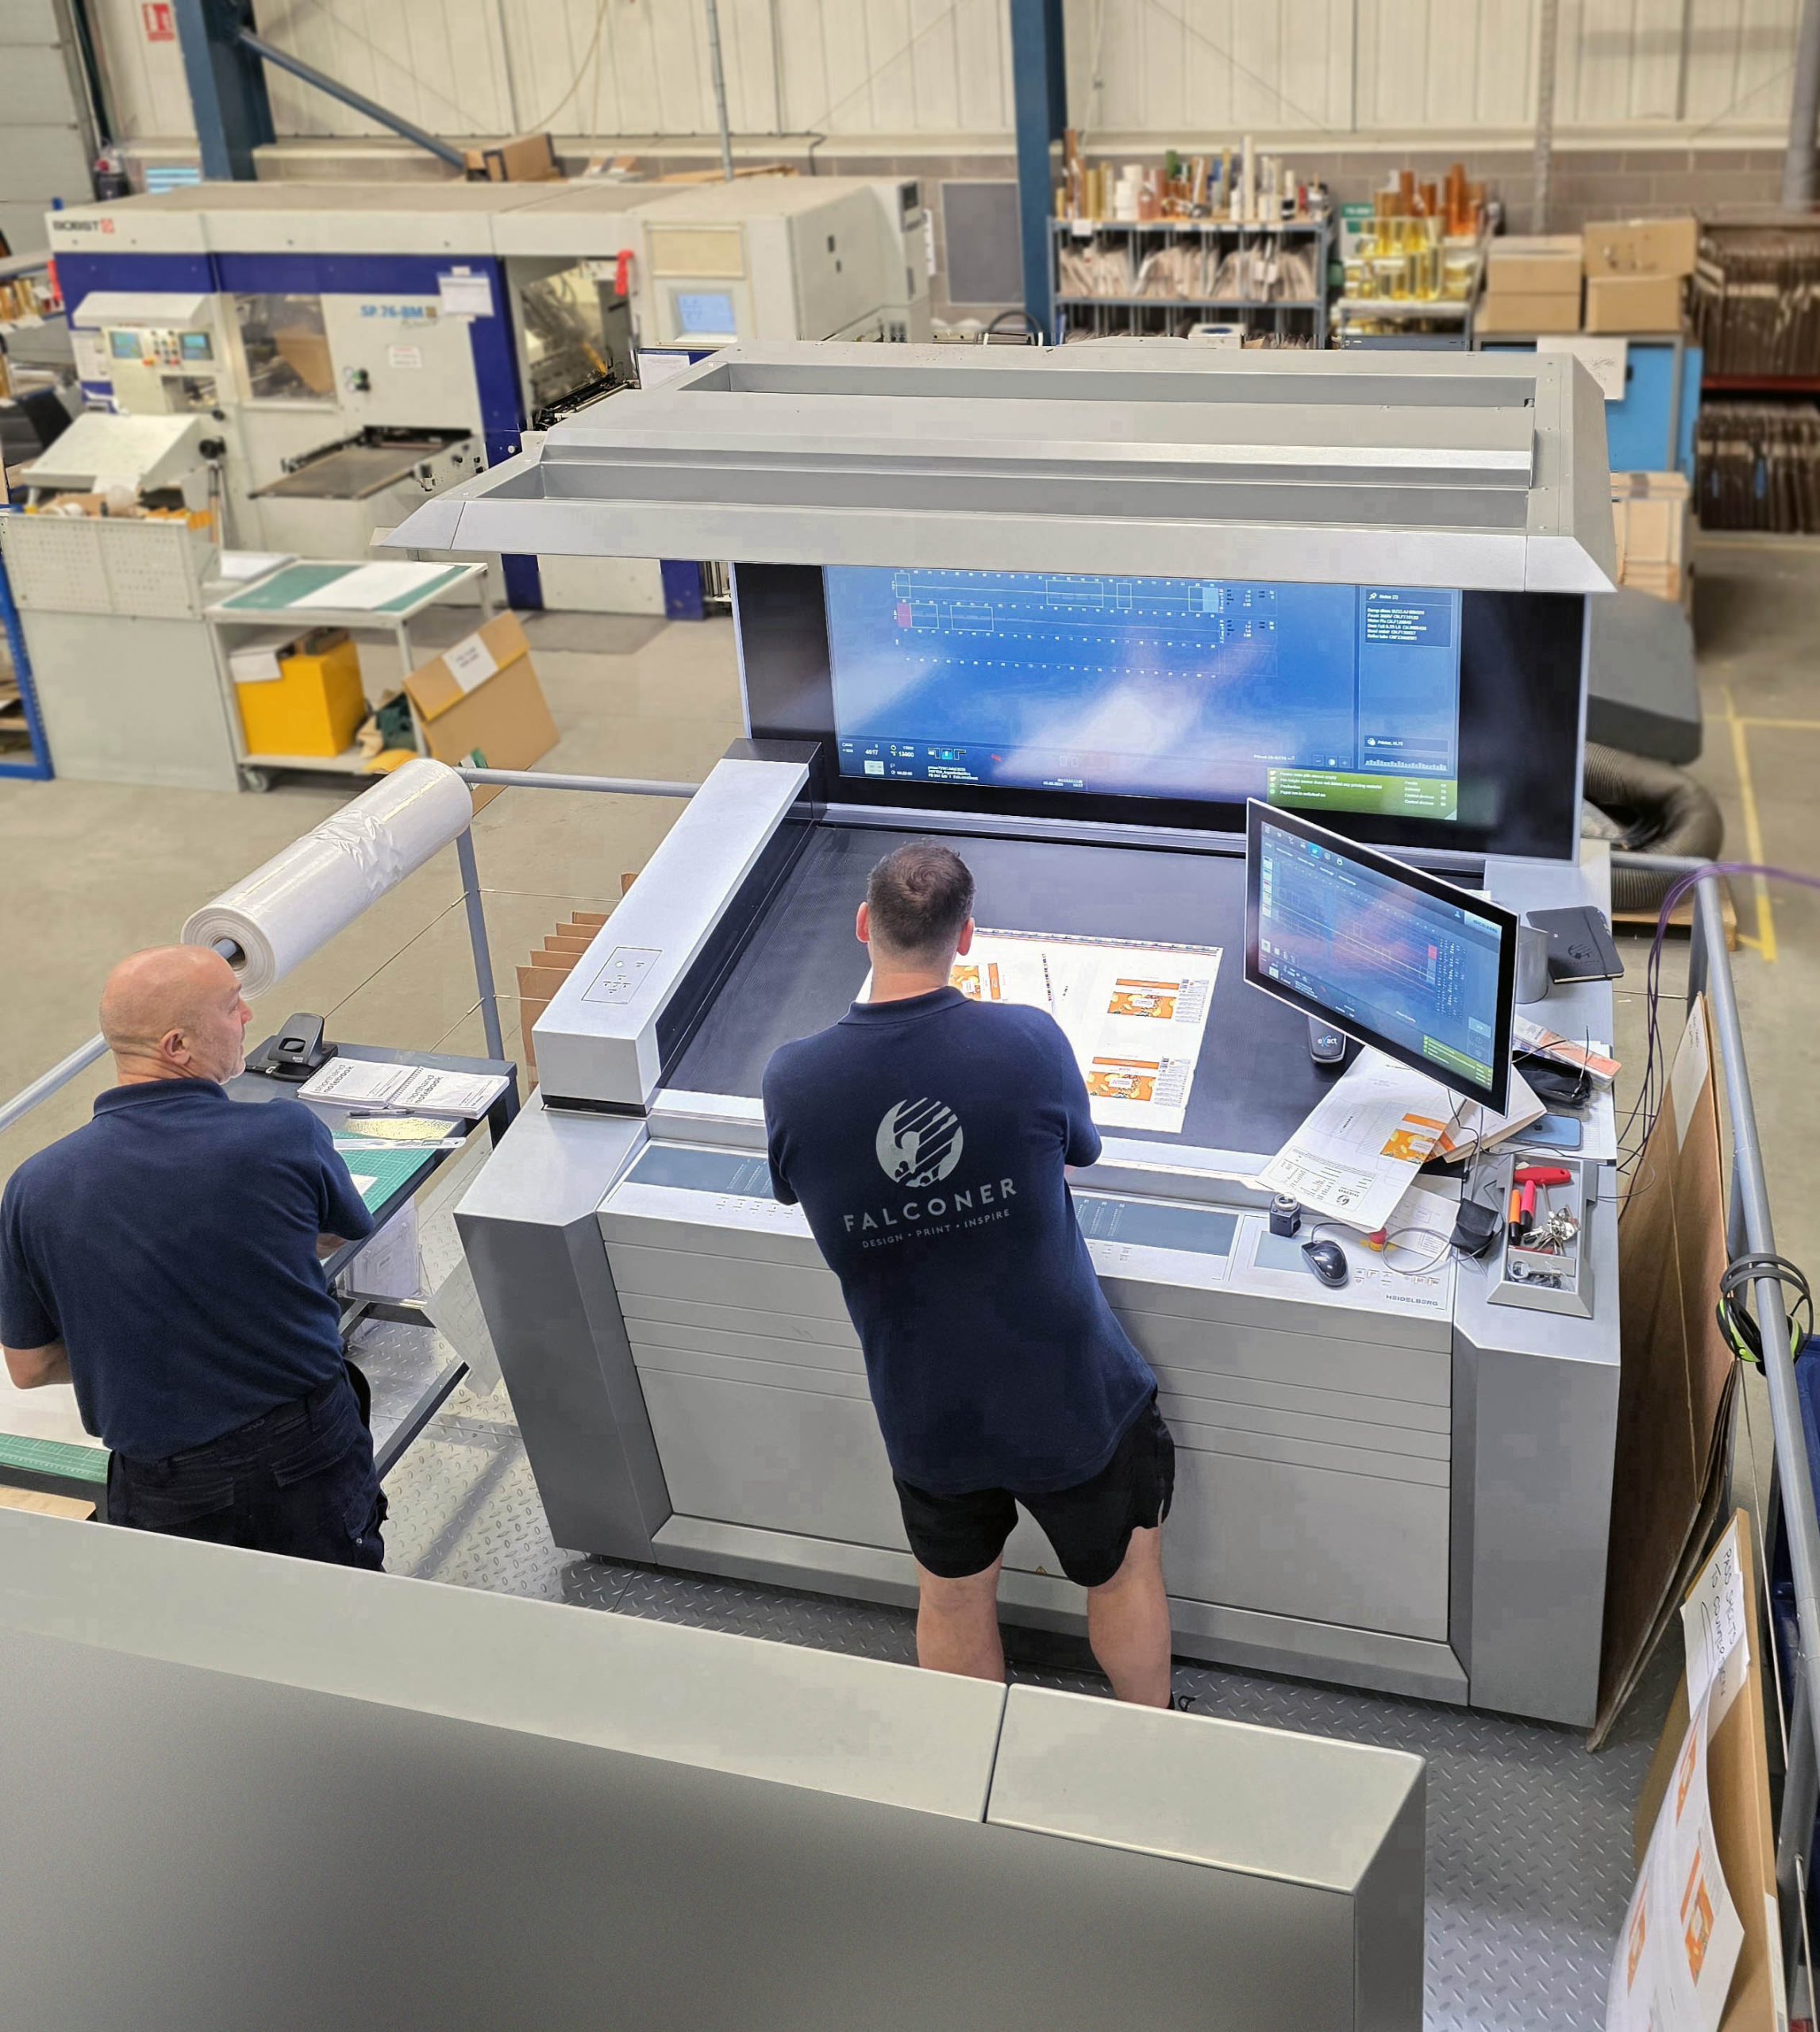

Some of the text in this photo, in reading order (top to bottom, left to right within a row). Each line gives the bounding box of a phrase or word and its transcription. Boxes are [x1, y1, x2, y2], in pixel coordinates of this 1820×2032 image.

[52, 220, 98, 232] BOBST
[324, 1065, 355, 1093] notebook
[415, 1076, 444, 1104] notebook
[843, 1177, 1017, 1232] FALCONER
[862, 1208, 1010, 1249] DESIGN PRINT INSPIRE
[1386, 1295, 1438, 1307] HEIDELBERG
